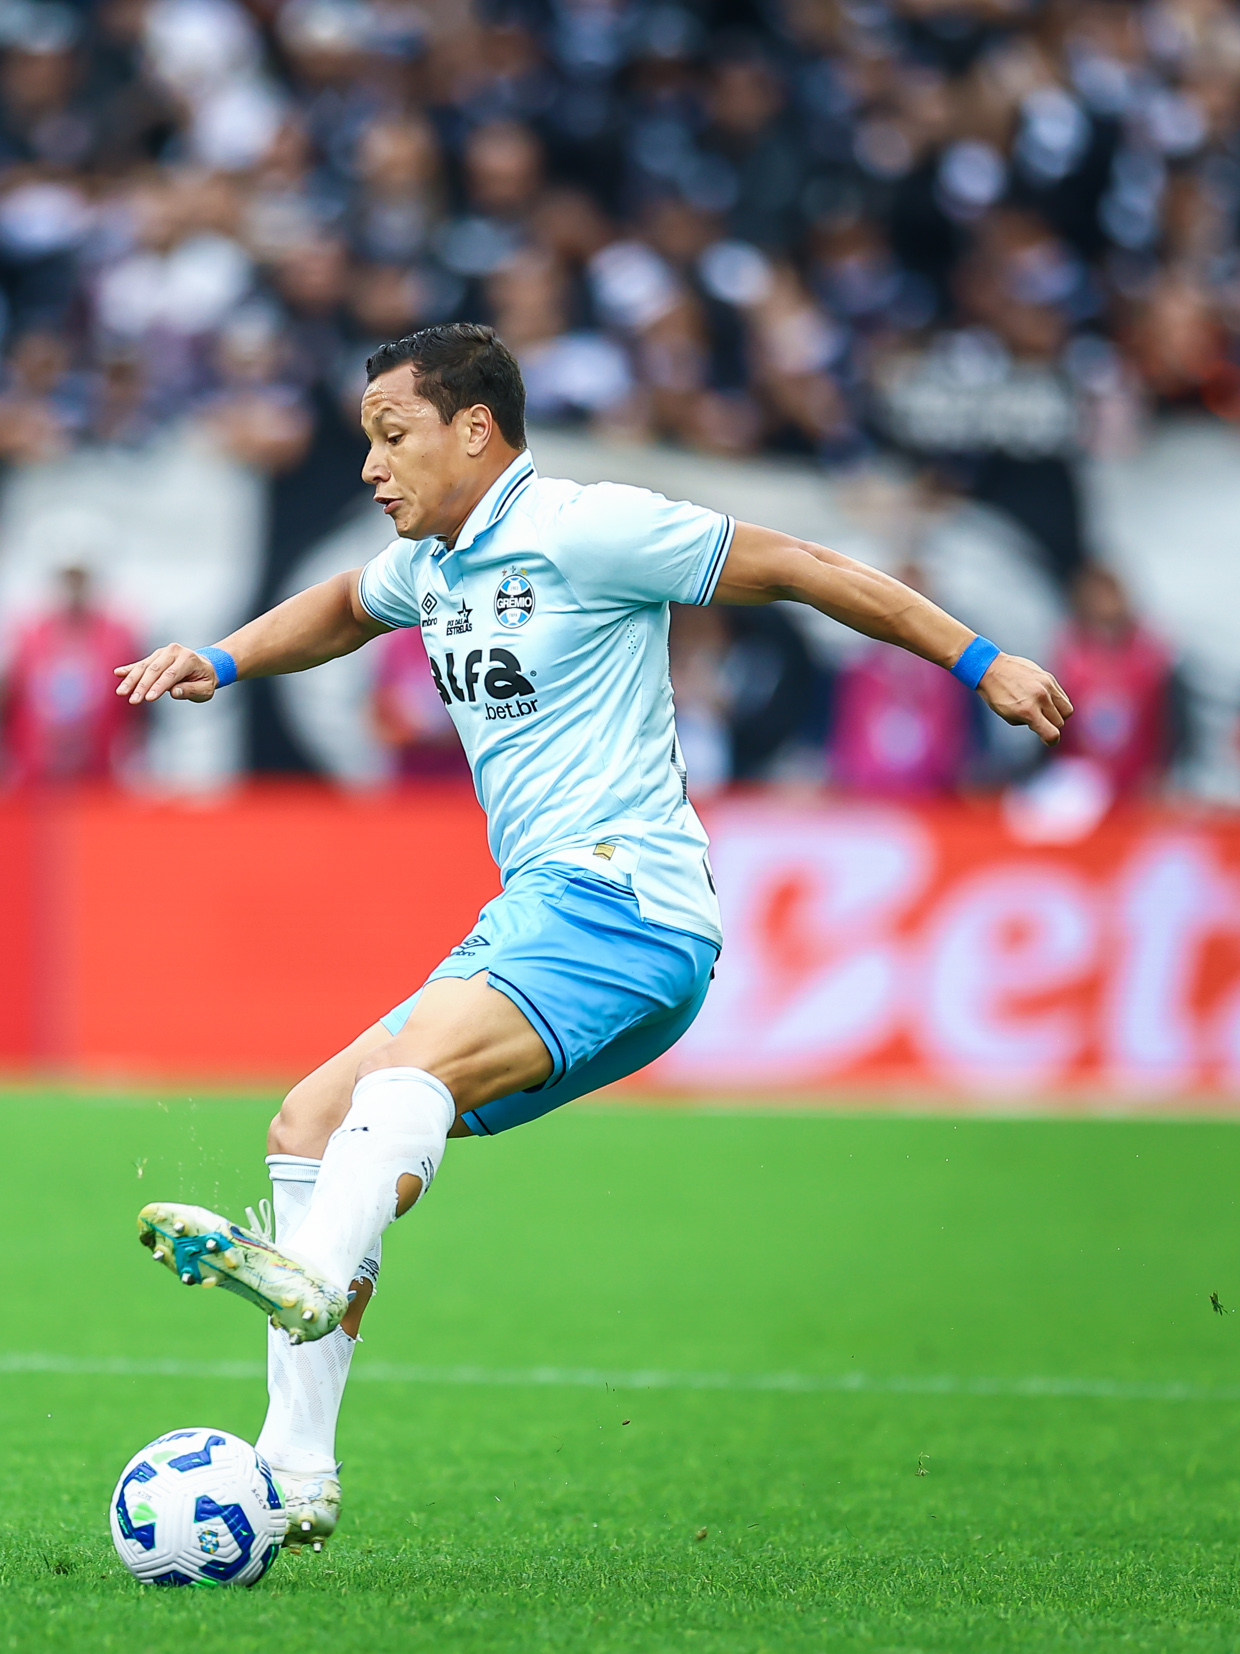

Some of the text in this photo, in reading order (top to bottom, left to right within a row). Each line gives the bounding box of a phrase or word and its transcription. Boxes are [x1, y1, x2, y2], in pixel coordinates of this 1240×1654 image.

[496, 595, 533, 609] GRÊMIO
[446, 622, 473, 636] ESTRELAS
[485, 698, 538, 720] .bet.br
[675, 805, 1240, 1082] Bet
